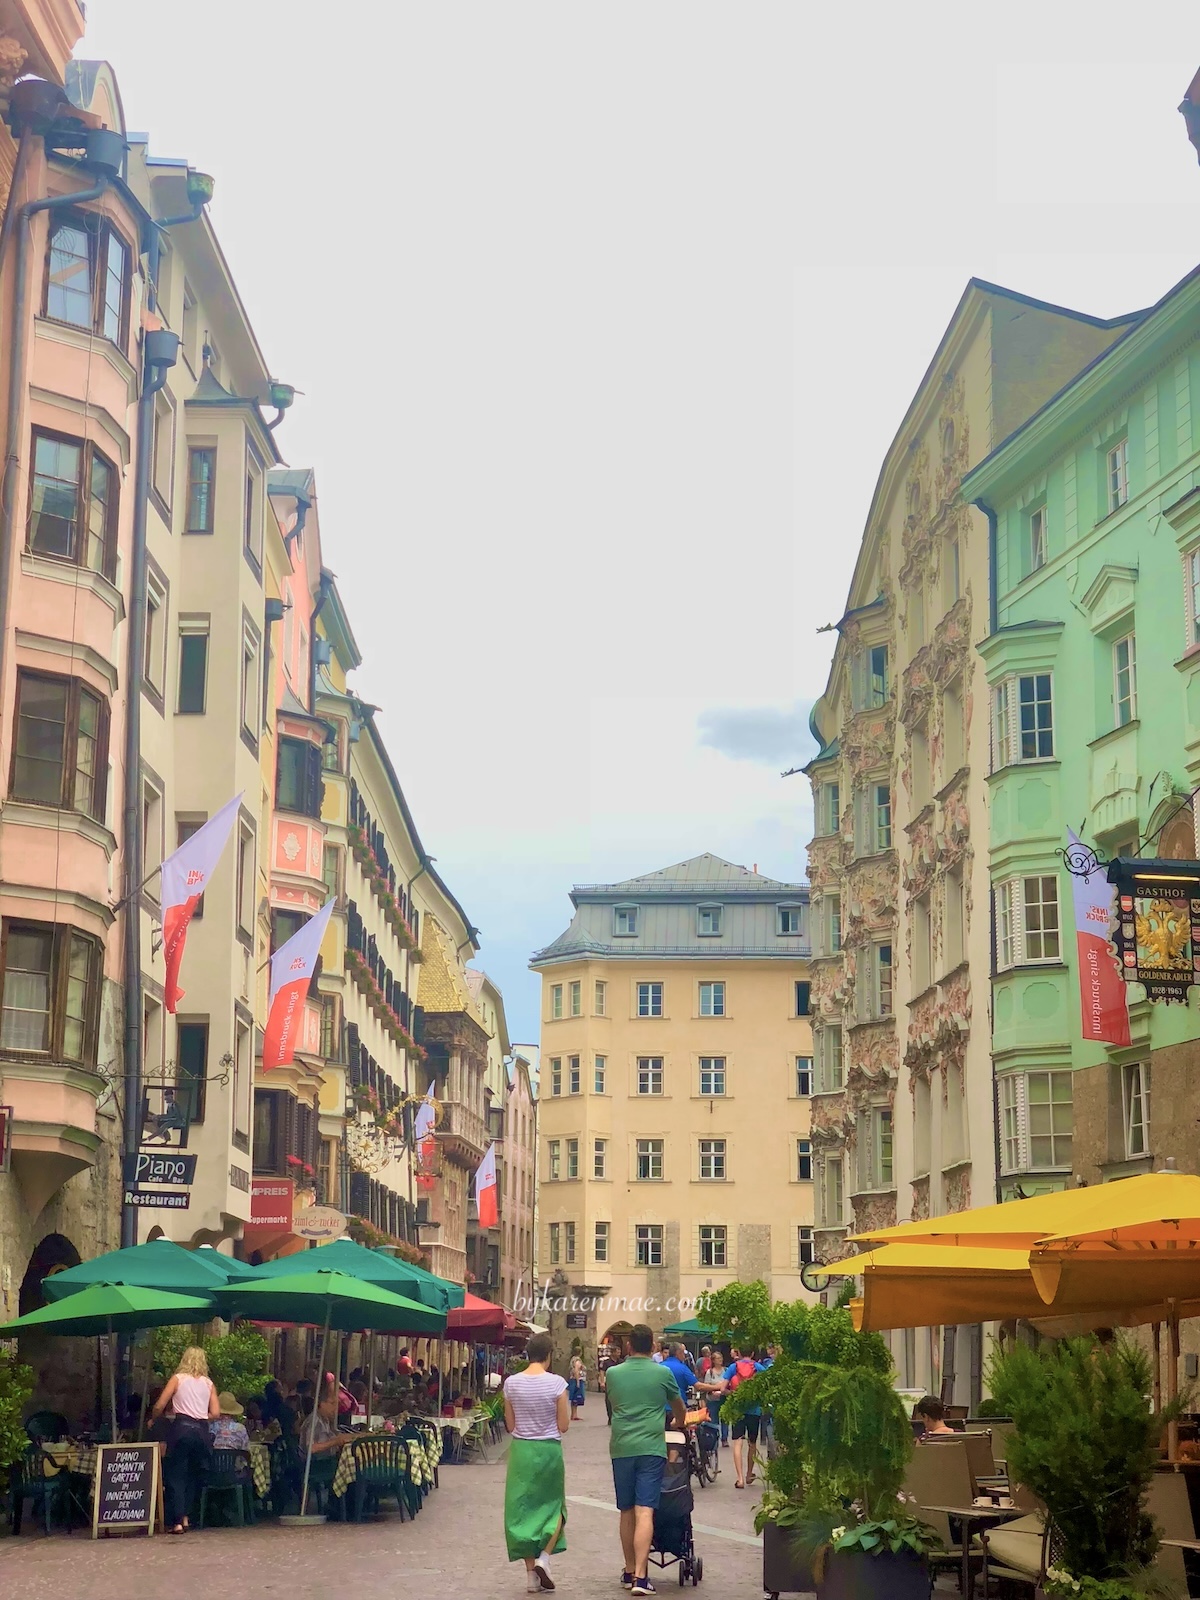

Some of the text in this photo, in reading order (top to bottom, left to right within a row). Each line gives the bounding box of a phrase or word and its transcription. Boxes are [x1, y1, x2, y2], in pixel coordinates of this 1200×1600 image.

[1136, 886, 1186, 898] GASTHOF
[1138, 970, 1172, 981] GOLDENER
[1172, 972, 1193, 982] ADLER
[277, 991, 300, 1062] Innsbruck singt
[134, 1154, 186, 1182] Piano
[172, 1176, 185, 1184] Bar
[124, 1191, 187, 1207] Restaurant
[115, 1452, 139, 1462] PIANO
[107, 1462, 146, 1473] ROMANTIK
[111, 1473, 141, 1483] GARTEN
[105, 1490, 144, 1501] INNENHOF
[118, 1501, 130, 1509] DER
[103, 1509, 145, 1520] CLAUDIANA
